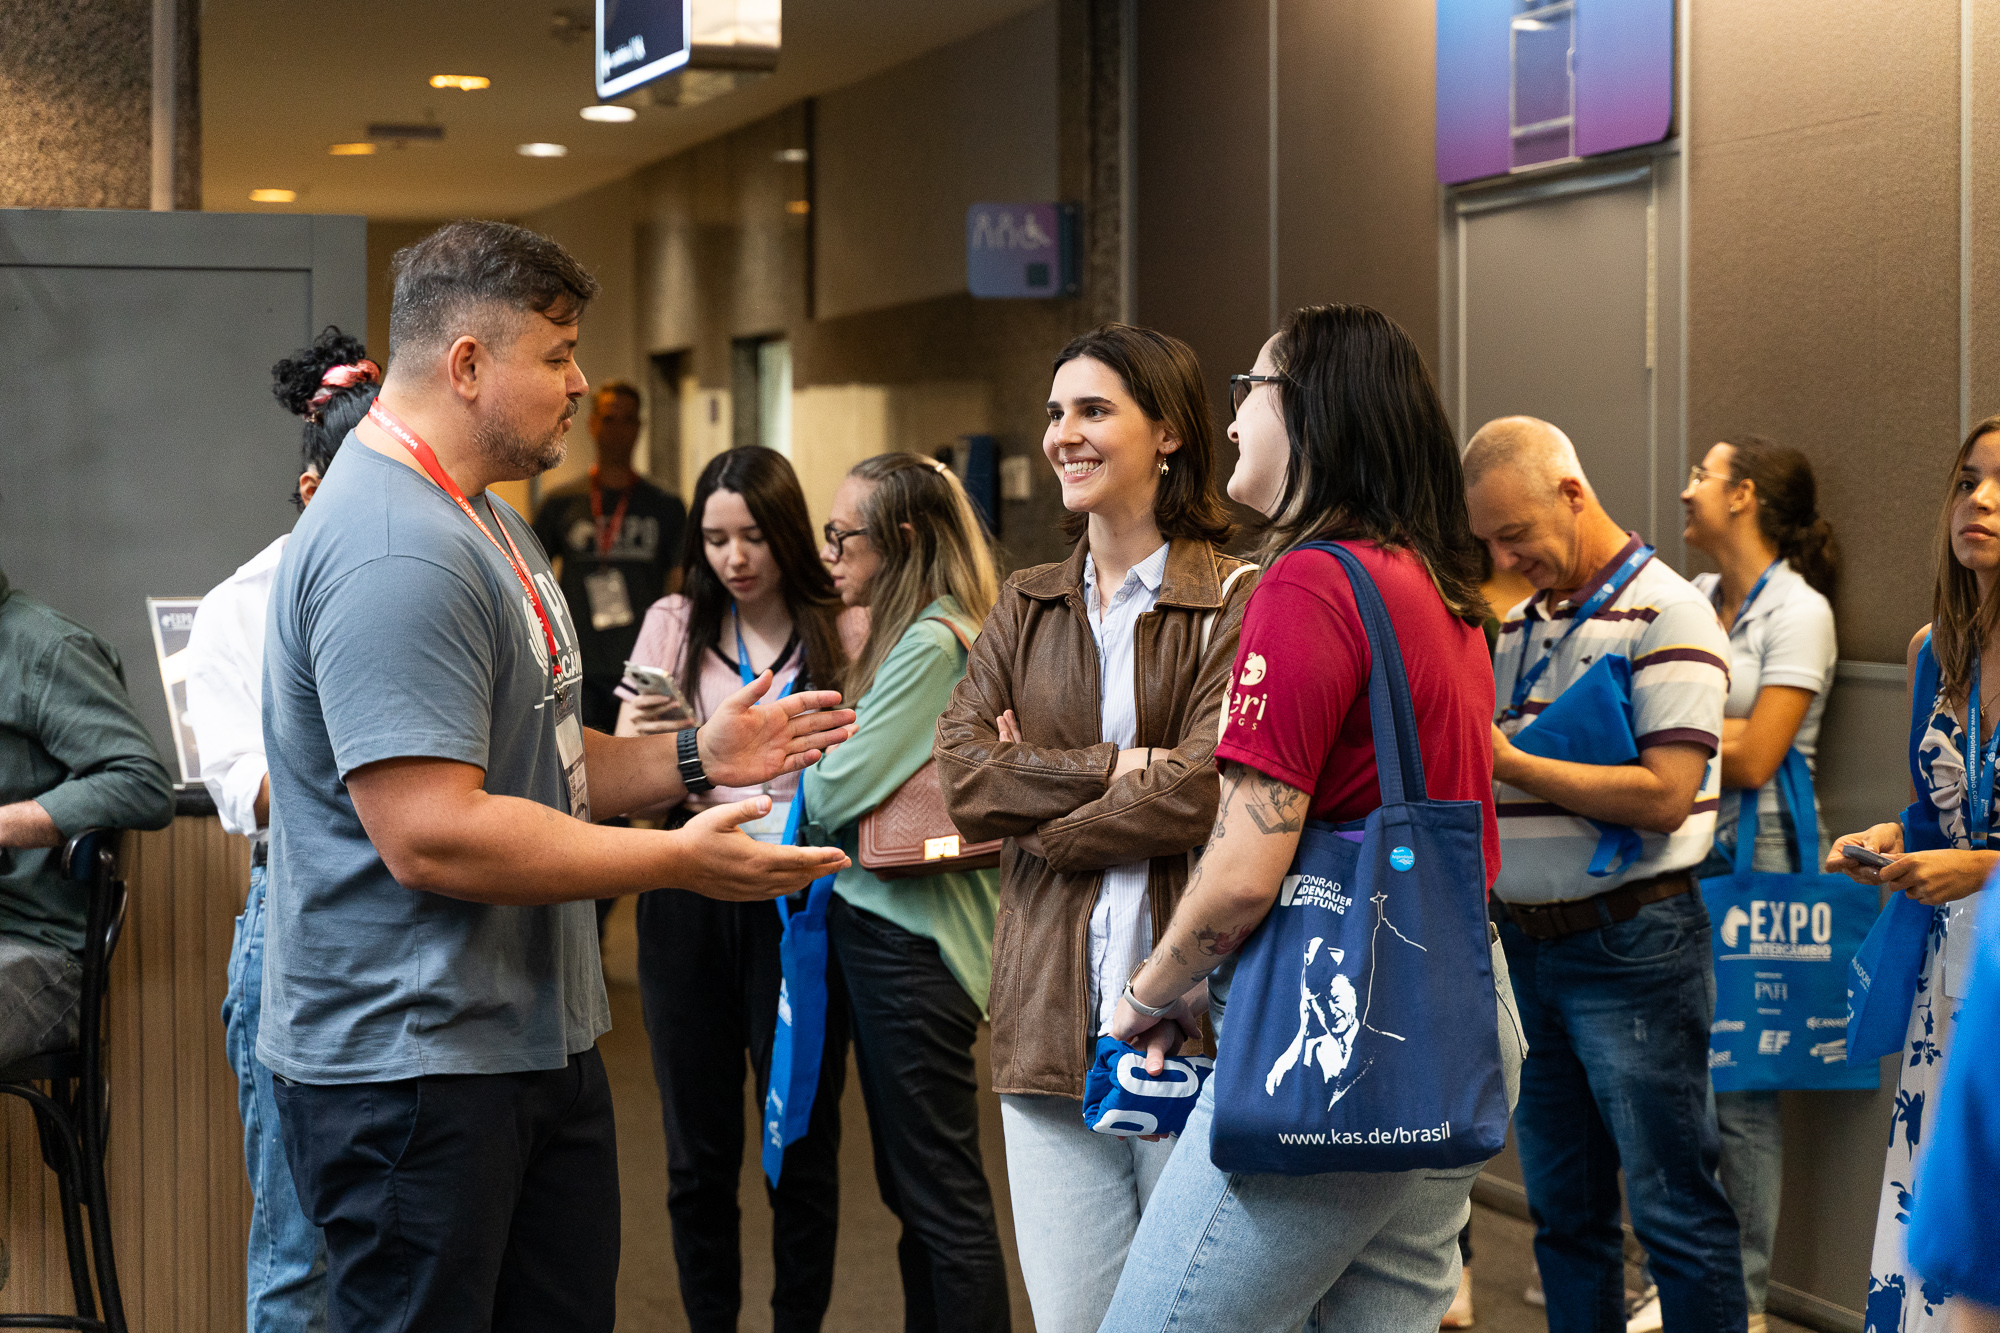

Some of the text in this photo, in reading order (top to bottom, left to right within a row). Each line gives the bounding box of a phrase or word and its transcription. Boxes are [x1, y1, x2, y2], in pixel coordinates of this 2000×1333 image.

[1750, 900, 1832, 944] EXPO
[1758, 1029, 1791, 1050] EF
[1278, 1121, 1451, 1145] www.kas.de/brasil
